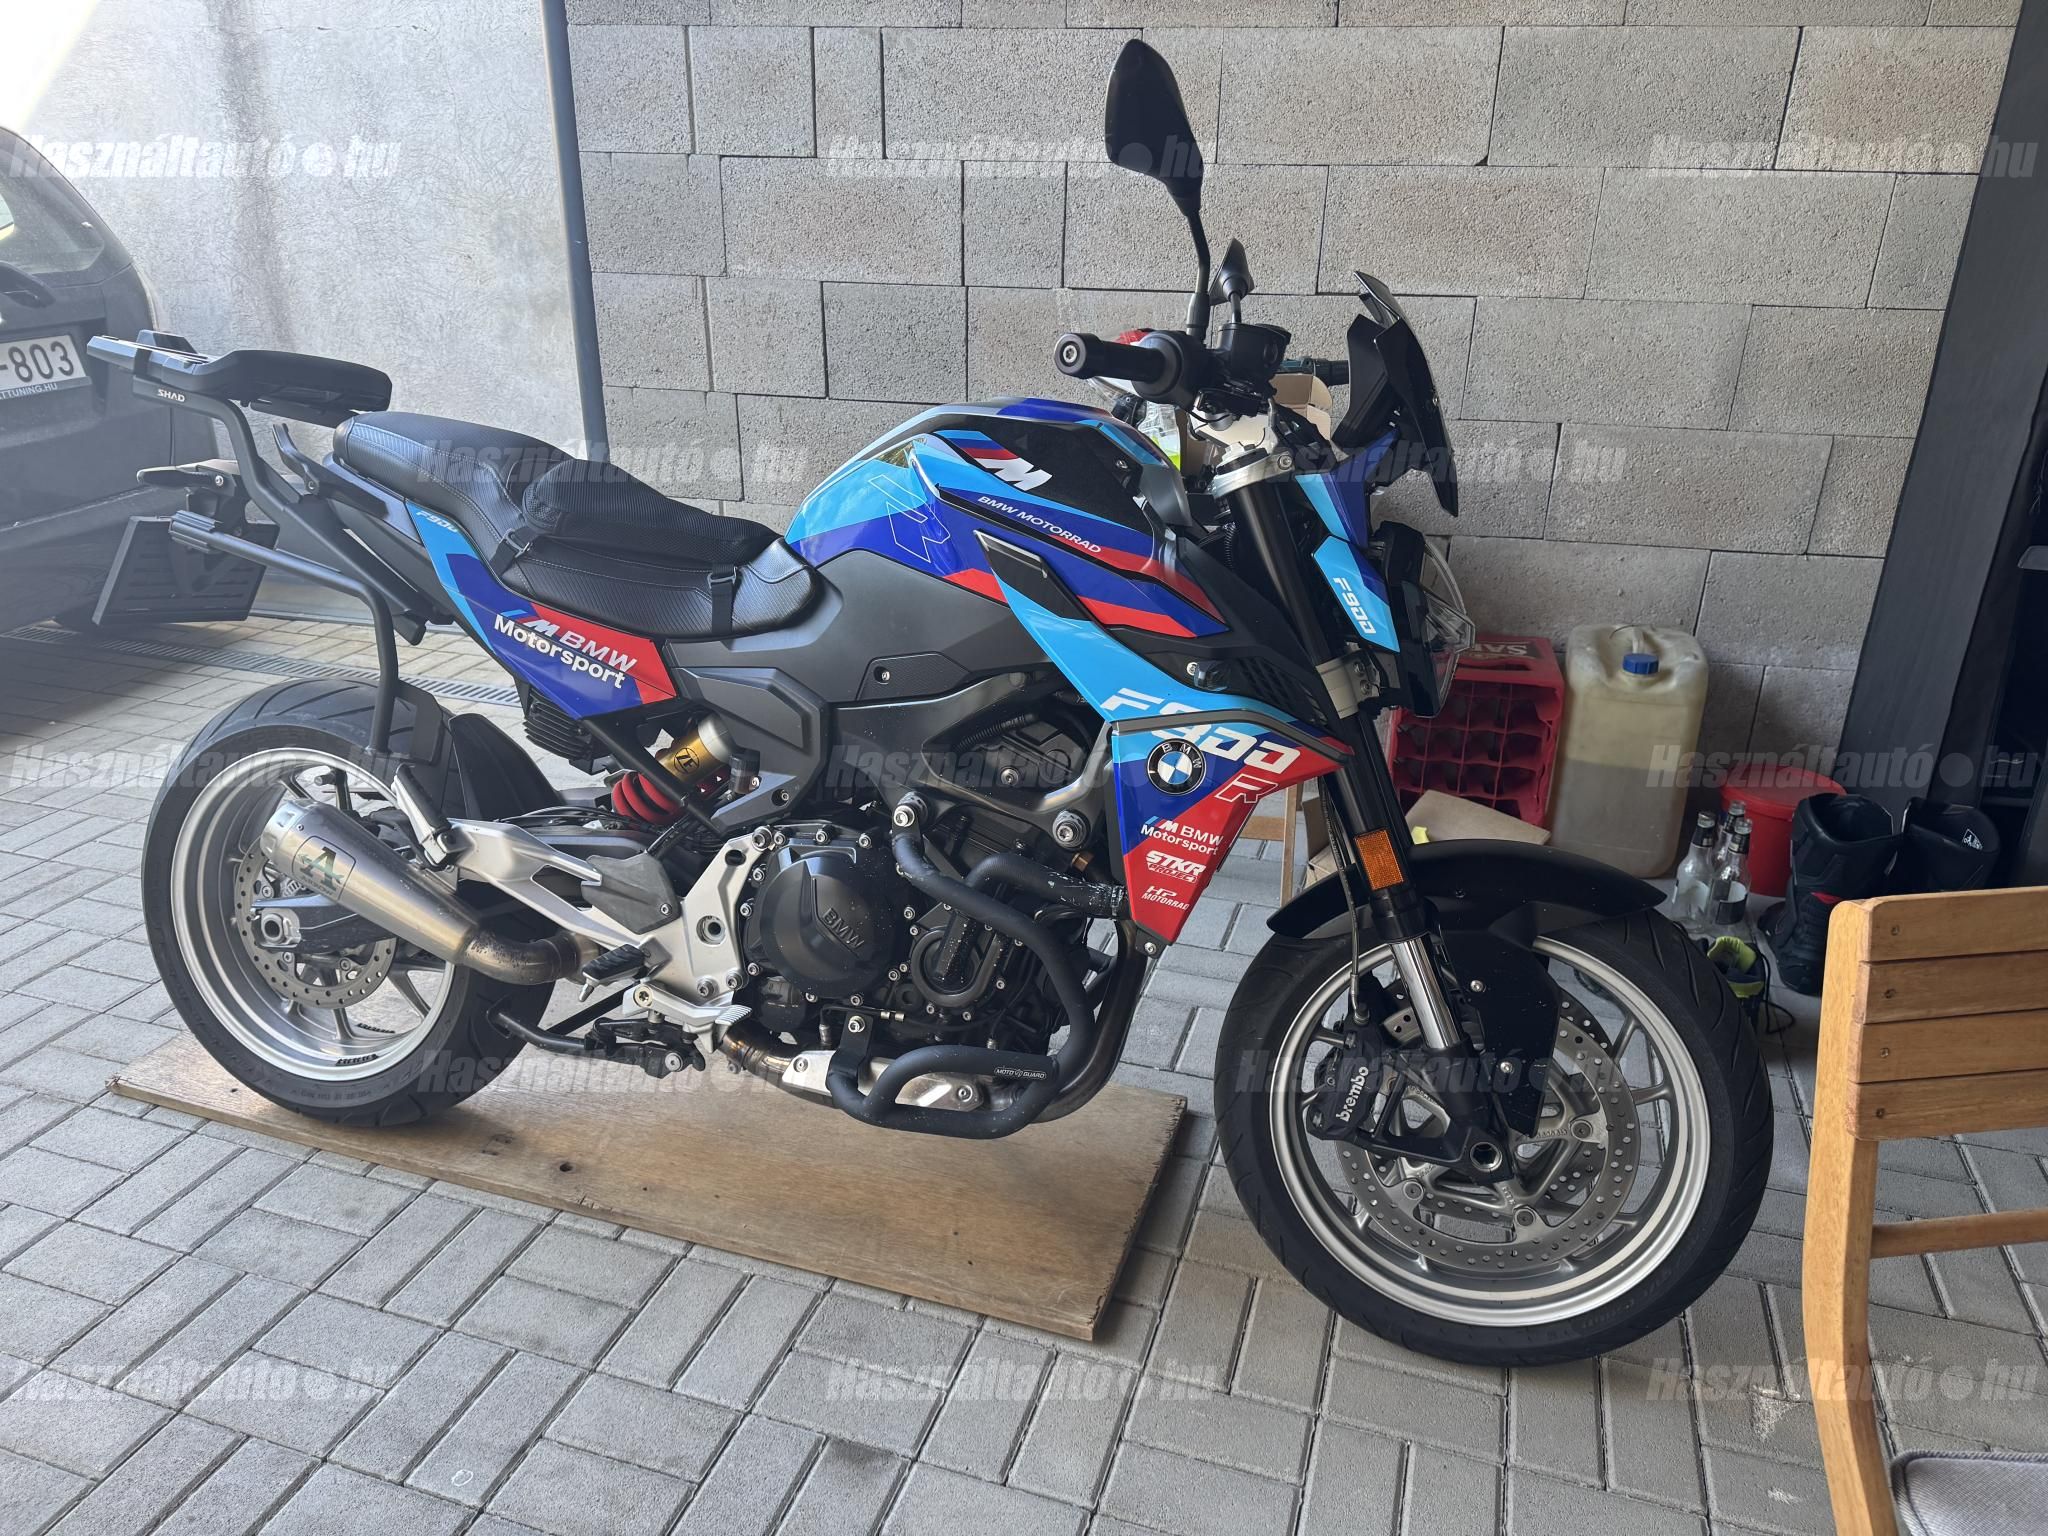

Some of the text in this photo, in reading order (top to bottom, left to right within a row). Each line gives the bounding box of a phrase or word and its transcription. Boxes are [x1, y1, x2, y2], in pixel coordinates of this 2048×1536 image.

[0, 382, 58, 400] TTUNING.HU
[157, 388, 185, 402] SHAD
[977, 495, 1102, 554] BMW MOTORRAD
[1332, 577, 1377, 634] F900
[494, 613, 627, 689] Motorsport
[559, 630, 638, 673] BMW
[1140, 824, 1219, 856] Motorsport
[1180, 824, 1224, 846] BMW
[1145, 850, 1207, 877] STKR
[1141, 892, 1191, 911] MOTORRAD
[1145, 885, 1178, 898] HP
[822, 907, 865, 949] BMW
[1335, 1066, 1369, 1122] brembo
